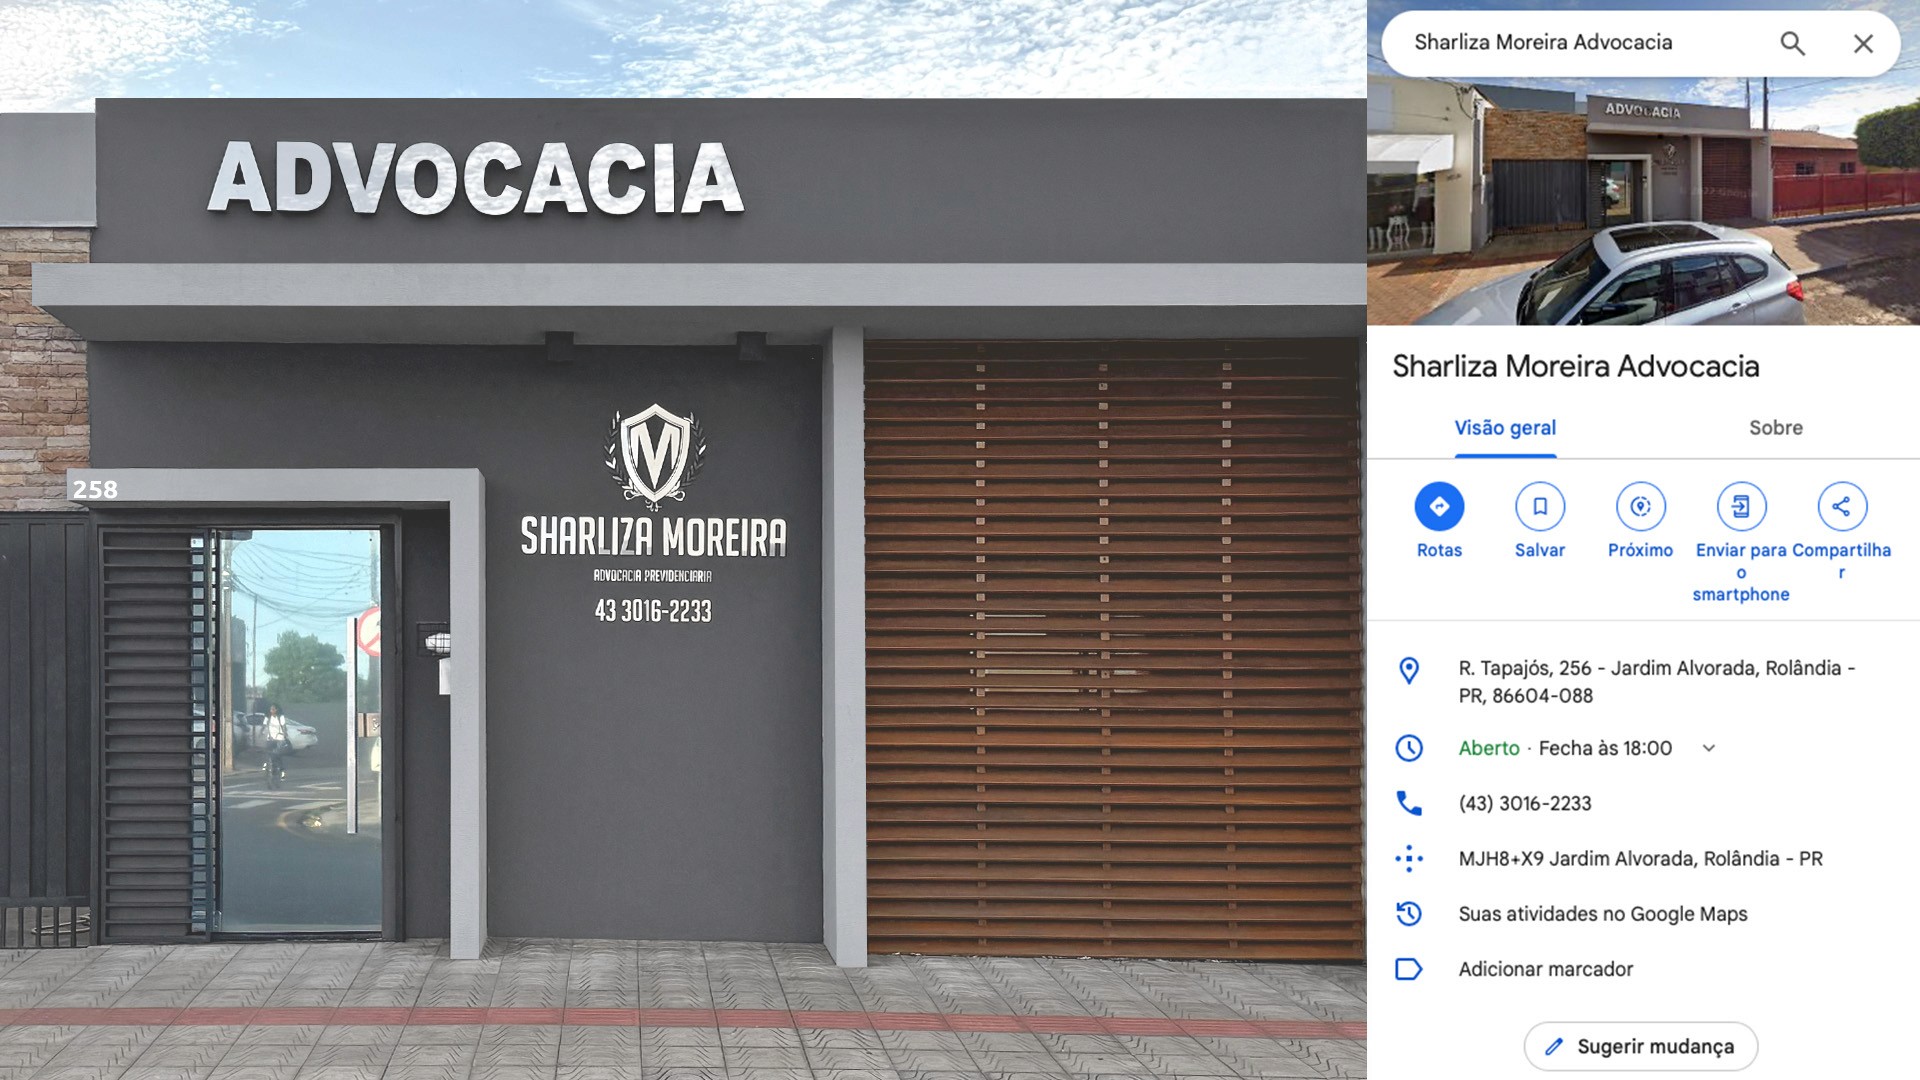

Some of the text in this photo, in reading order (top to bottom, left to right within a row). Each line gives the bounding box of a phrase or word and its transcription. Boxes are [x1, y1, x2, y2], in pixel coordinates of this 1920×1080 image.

[1415, 32, 1673, 51] Sharliza Moreira Advocacia
[207, 141, 745, 215] ADVOCACIA
[1393, 353, 1760, 378] Sharliza Moreira Advocacia
[1454, 418, 1557, 440] Visão geral
[1749, 418, 1804, 436] Sobre
[73, 480, 118, 499] 258
[521, 516, 787, 557] SHARLIZA MOREIRA
[1417, 543, 1463, 558] Rotas
[1515, 542, 1566, 558] Salvar
[1608, 542, 1674, 558] Próximo
[1696, 542, 1787, 561] Enviar para
[1792, 542, 1892, 561] Compartilha
[594, 568, 641, 582] ADVOCACIA
[1736, 567, 1747, 580] o
[1839, 567, 1846, 580] r
[1692, 586, 1790, 605] smartphone
[595, 599, 712, 623] 43 3016-2233
[1459, 660, 1475, 676] R.
[1480, 659, 1554, 680] Tapajós,
[1559, 659, 1592, 676] 256
[1610, 659, 1672, 676] Jardim
[1676, 659, 1760, 679] Alvorada,
[1766, 659, 1842, 676] Rolândia
[1459, 687, 1594, 706] PR, 86604-088
[1458, 739, 1521, 756] Aberto
[1539, 739, 1593, 756] Fecha
[1598, 739, 1619, 756] às
[1623, 740, 1673, 756] 18:00
[1459, 794, 1592, 814] (43) 3016-2233
[1459, 850, 1544, 867] MJH8+X9
[1549, 849, 1610, 867] Jardim
[1614, 849, 1698, 869] Alvorada,
[1704, 849, 1780, 867] Rolândia
[1799, 850, 1823, 867] PR
[1459, 905, 1748, 926] Suas atividades no Google Maps
[1458, 960, 1634, 977] Adicionar marcador
[1578, 1037, 1735, 1059] Sugerir mudança
